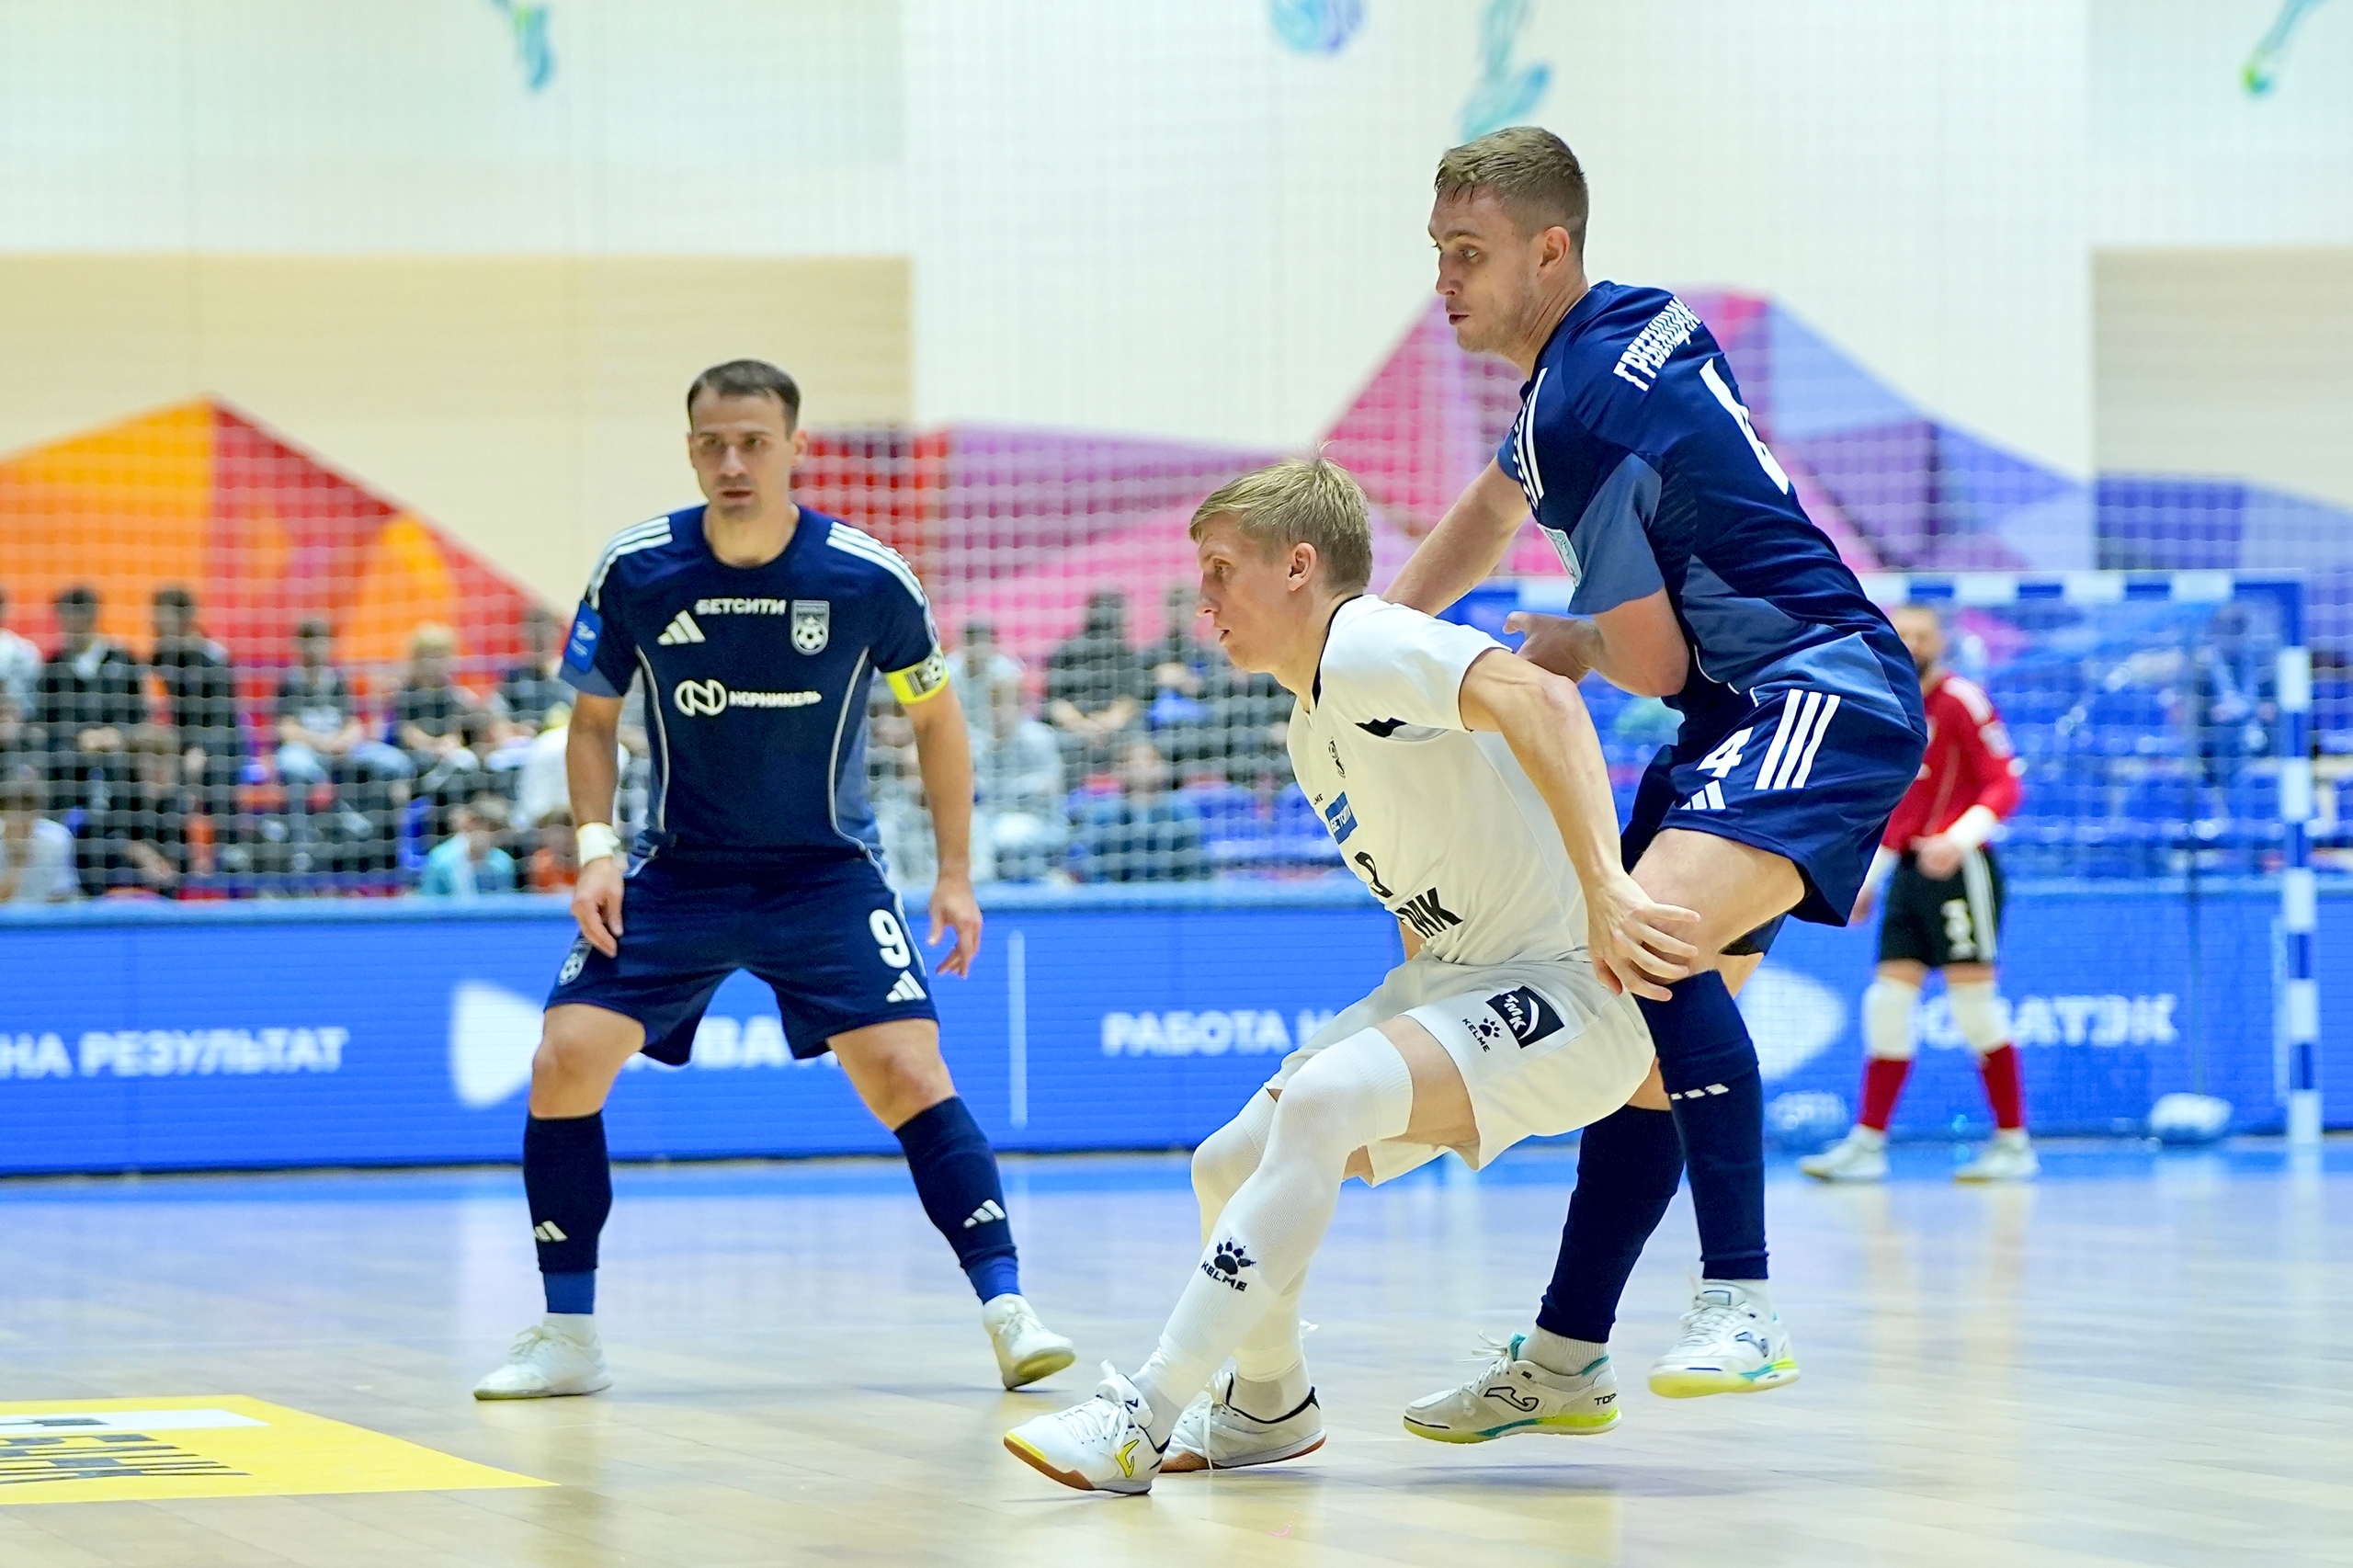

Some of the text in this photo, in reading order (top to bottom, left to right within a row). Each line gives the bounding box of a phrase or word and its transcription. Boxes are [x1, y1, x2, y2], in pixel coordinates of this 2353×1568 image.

[1613, 295, 1701, 392] ГРЕБЕНЩИК
[694, 597, 787, 616] БЕТСИТИ
[728, 690, 823, 708] НОРНИКЕЛЬ
[1696, 726, 1754, 778] 4
[869, 909, 912, 969] 9
[78, 1027, 349, 1076] РЕЗУЛЬТАТ
[1101, 1009, 1291, 1057] РАБОТА
[1462, 1017, 1490, 1052] KELME
[1200, 1260, 1247, 1291] KELME
